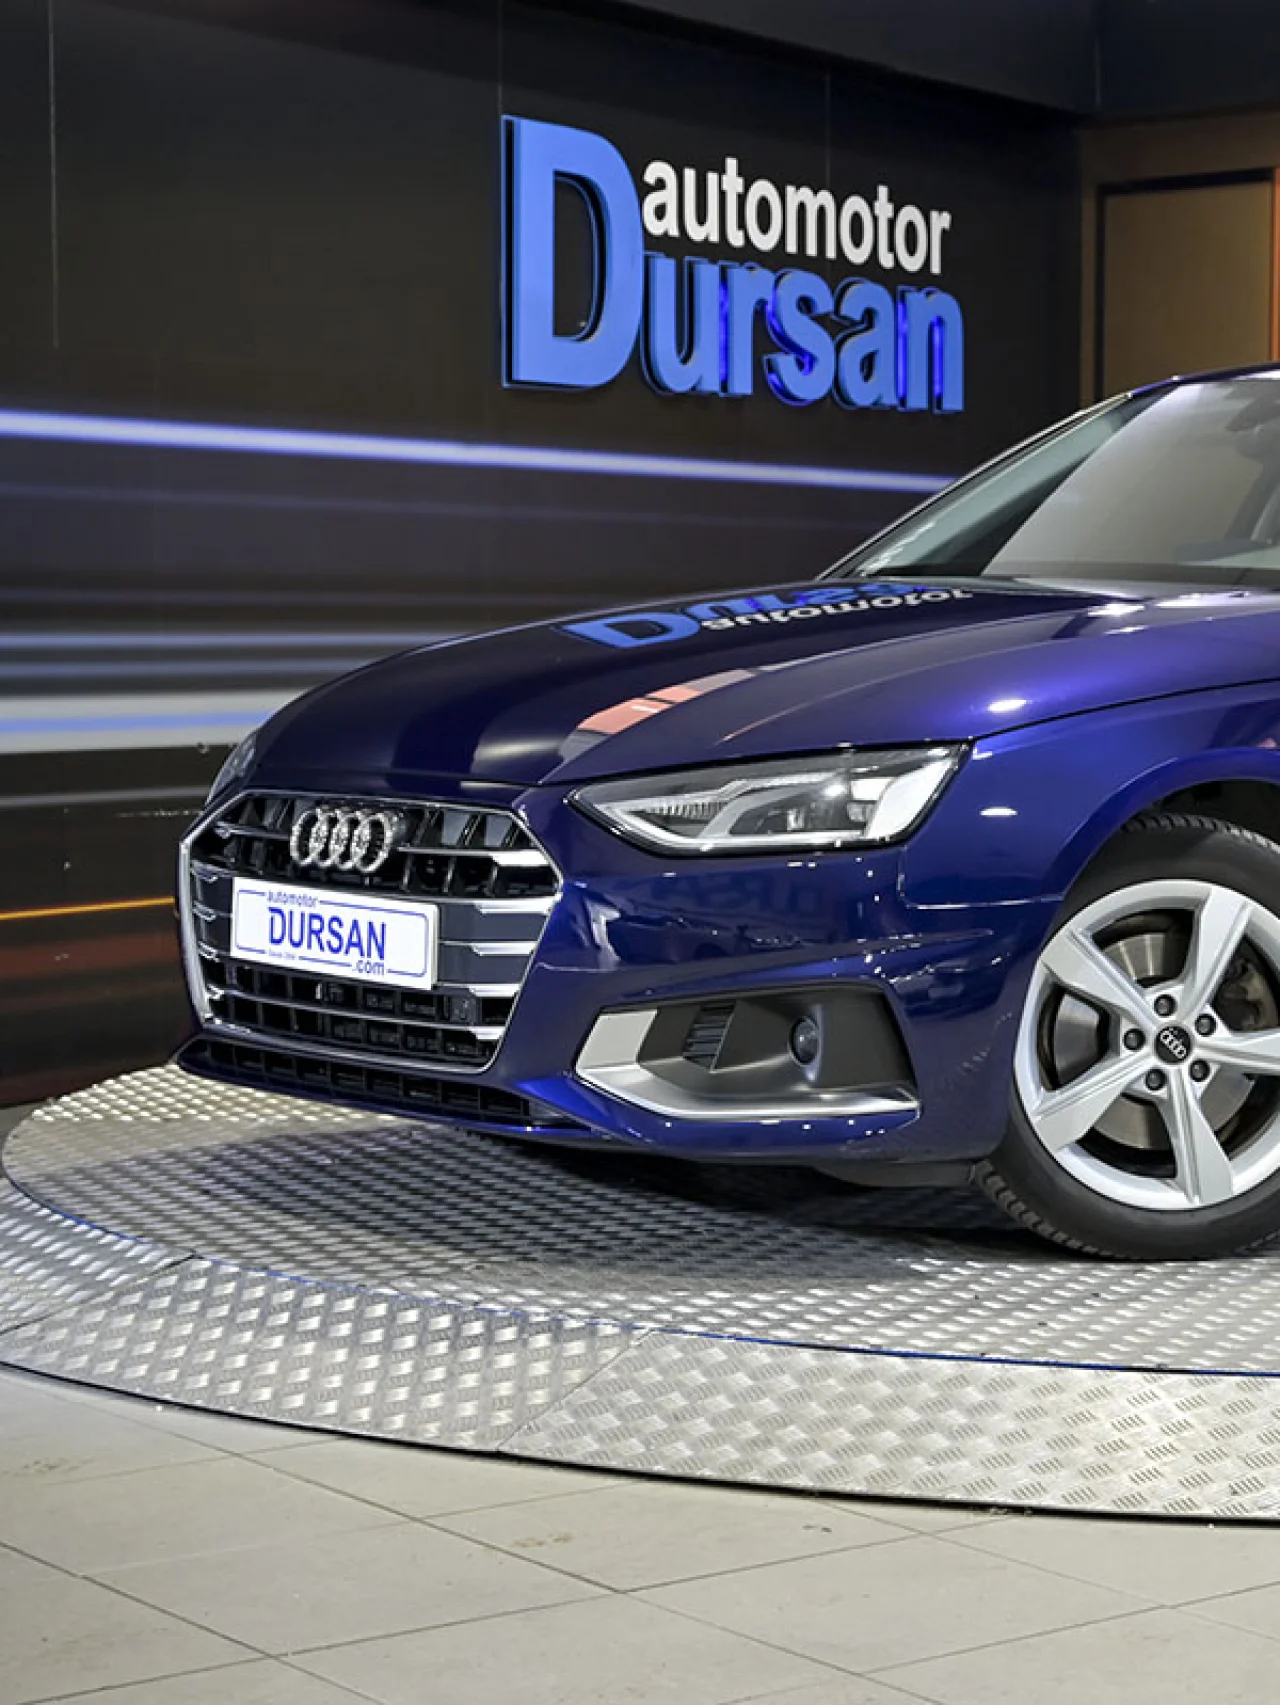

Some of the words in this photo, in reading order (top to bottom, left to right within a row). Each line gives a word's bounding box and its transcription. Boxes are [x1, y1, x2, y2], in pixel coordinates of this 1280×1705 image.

[642, 157, 952, 274] automotor
[501, 113, 965, 414] Dursan
[267, 890, 318, 907] automotor
[268, 906, 386, 960] DURSAN
[353, 959, 385, 976] .com
